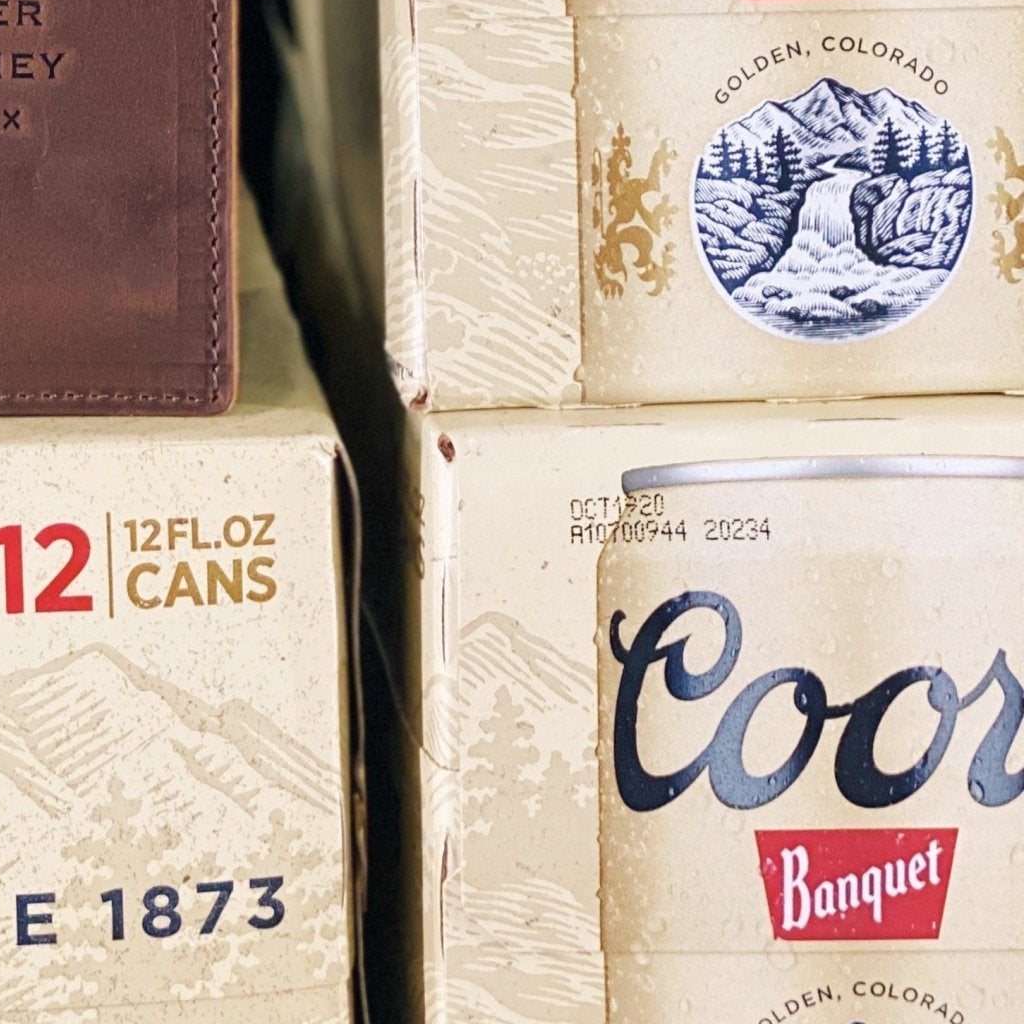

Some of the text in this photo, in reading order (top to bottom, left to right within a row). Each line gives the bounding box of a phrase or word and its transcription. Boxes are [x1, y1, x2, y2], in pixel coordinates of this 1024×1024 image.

[715, 36, 949, 105] GOLDEN, COLORADO
[703, 517, 771, 541] 20234
[126, 556, 278, 610] CANS
[99, 875, 286, 941] 1873
[780, 839, 943, 932] Banquet
